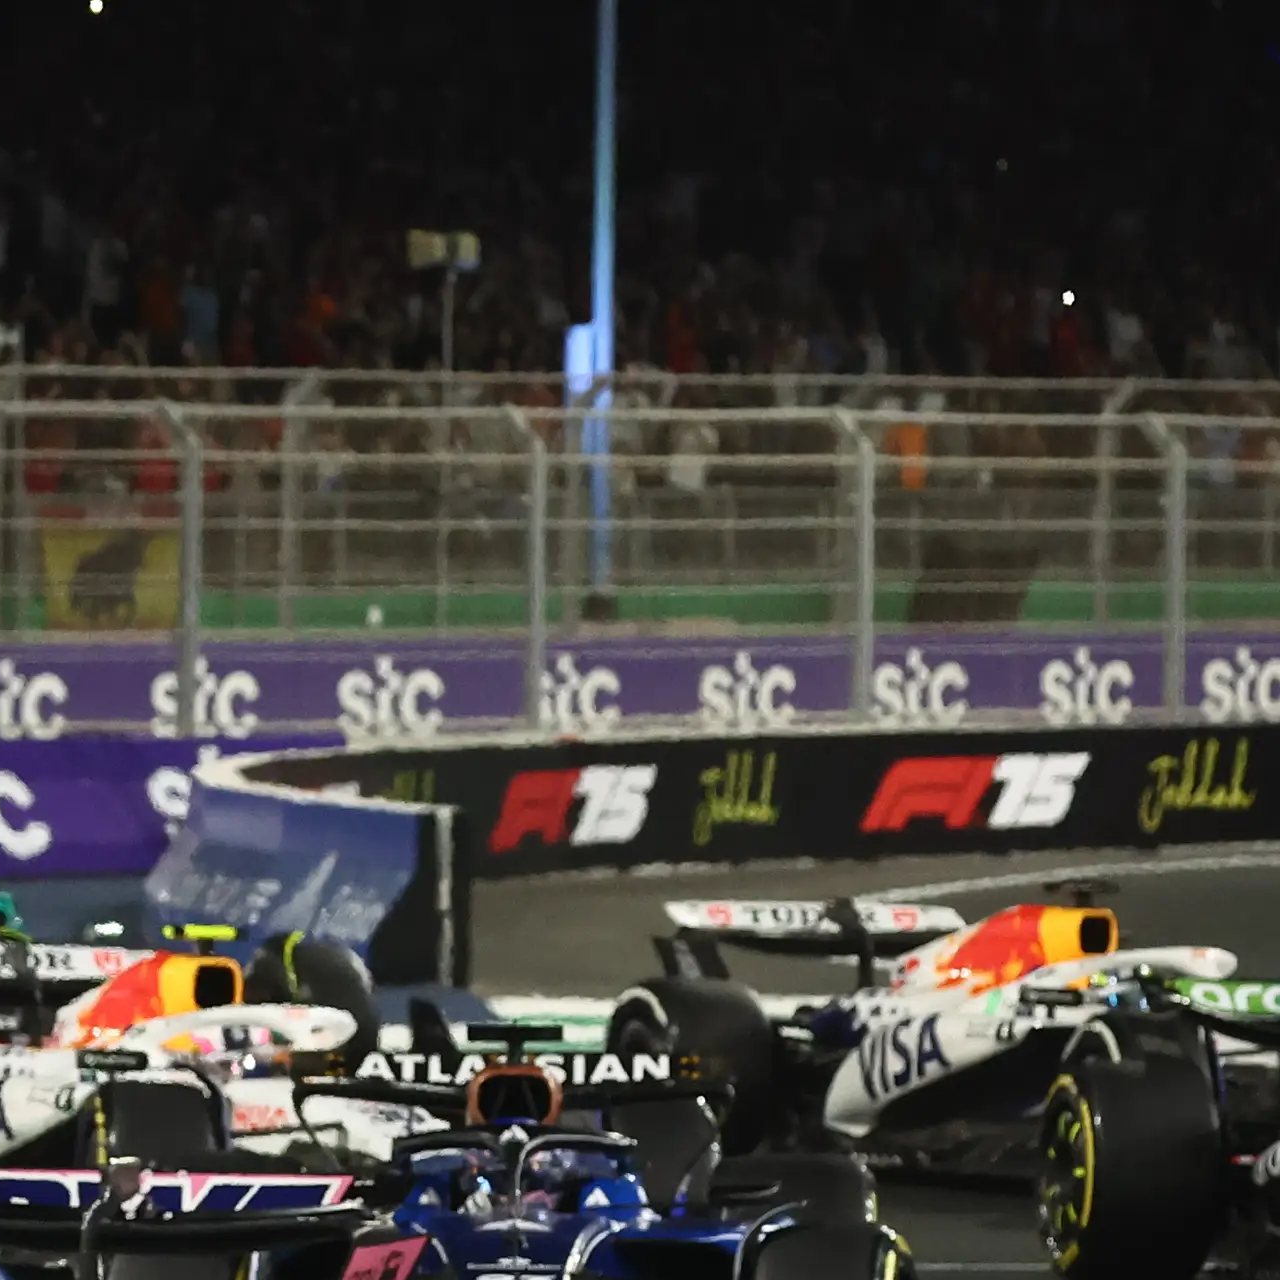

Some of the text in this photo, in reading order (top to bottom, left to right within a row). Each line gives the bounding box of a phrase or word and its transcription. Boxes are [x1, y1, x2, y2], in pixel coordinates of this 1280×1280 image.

[149, 655, 261, 739] stc
[336, 653, 446, 736] stc
[698, 649, 797, 727] stc
[870, 646, 970, 726] stc
[1040, 645, 1135, 725] stc
[985, 750, 1092, 830] 75
[355, 1052, 674, 1086] ATLASIAN
[858, 1011, 952, 1100] VISA
